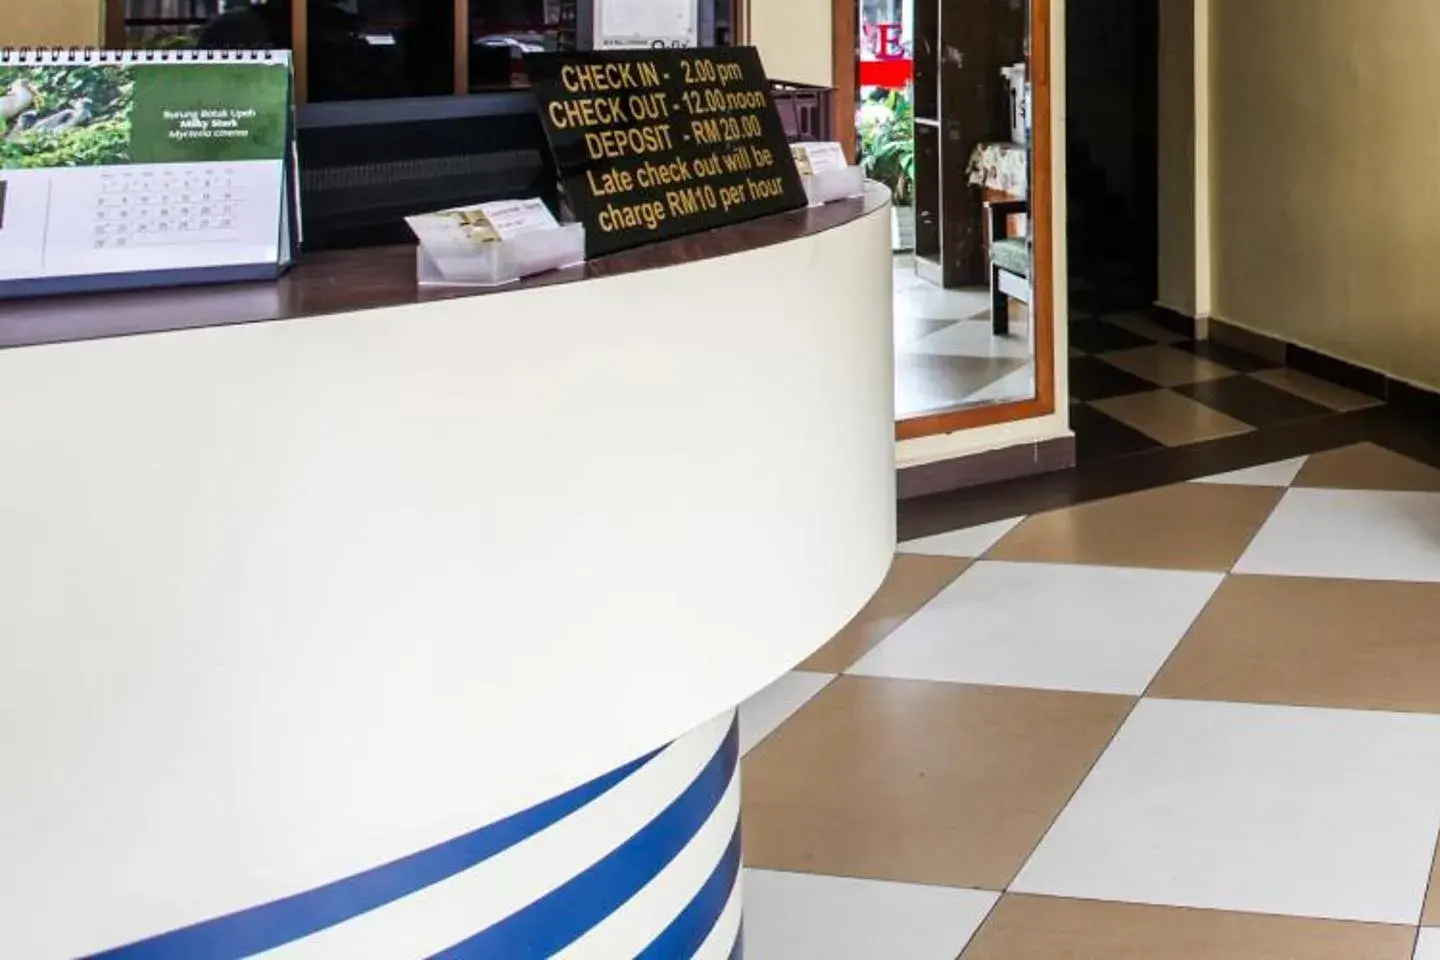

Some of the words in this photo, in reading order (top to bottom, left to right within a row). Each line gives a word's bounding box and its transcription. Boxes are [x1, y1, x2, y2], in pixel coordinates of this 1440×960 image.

[561, 62, 637, 92] CHECK
[637, 61, 661, 87] IN
[681, 59, 714, 84] 2.00
[718, 61, 743, 87] pm
[548, 96, 628, 130] CHECK
[628, 92, 670, 121] OUT
[681, 89, 727, 115] 12.00
[727, 91, 767, 110] noon
[584, 125, 673, 160] DEPOSIT
[691, 119, 721, 145] RM
[720, 114, 762, 140] 20.00
[586, 169, 634, 197] Late
[637, 156, 690, 189] check
[693, 154, 724, 176] out
[724, 146, 751, 171] will
[750, 145, 774, 168] be
[598, 203, 667, 232] charge
[666, 186, 718, 218] RM10
[720, 185, 747, 212] per
[747, 176, 785, 200] hour
